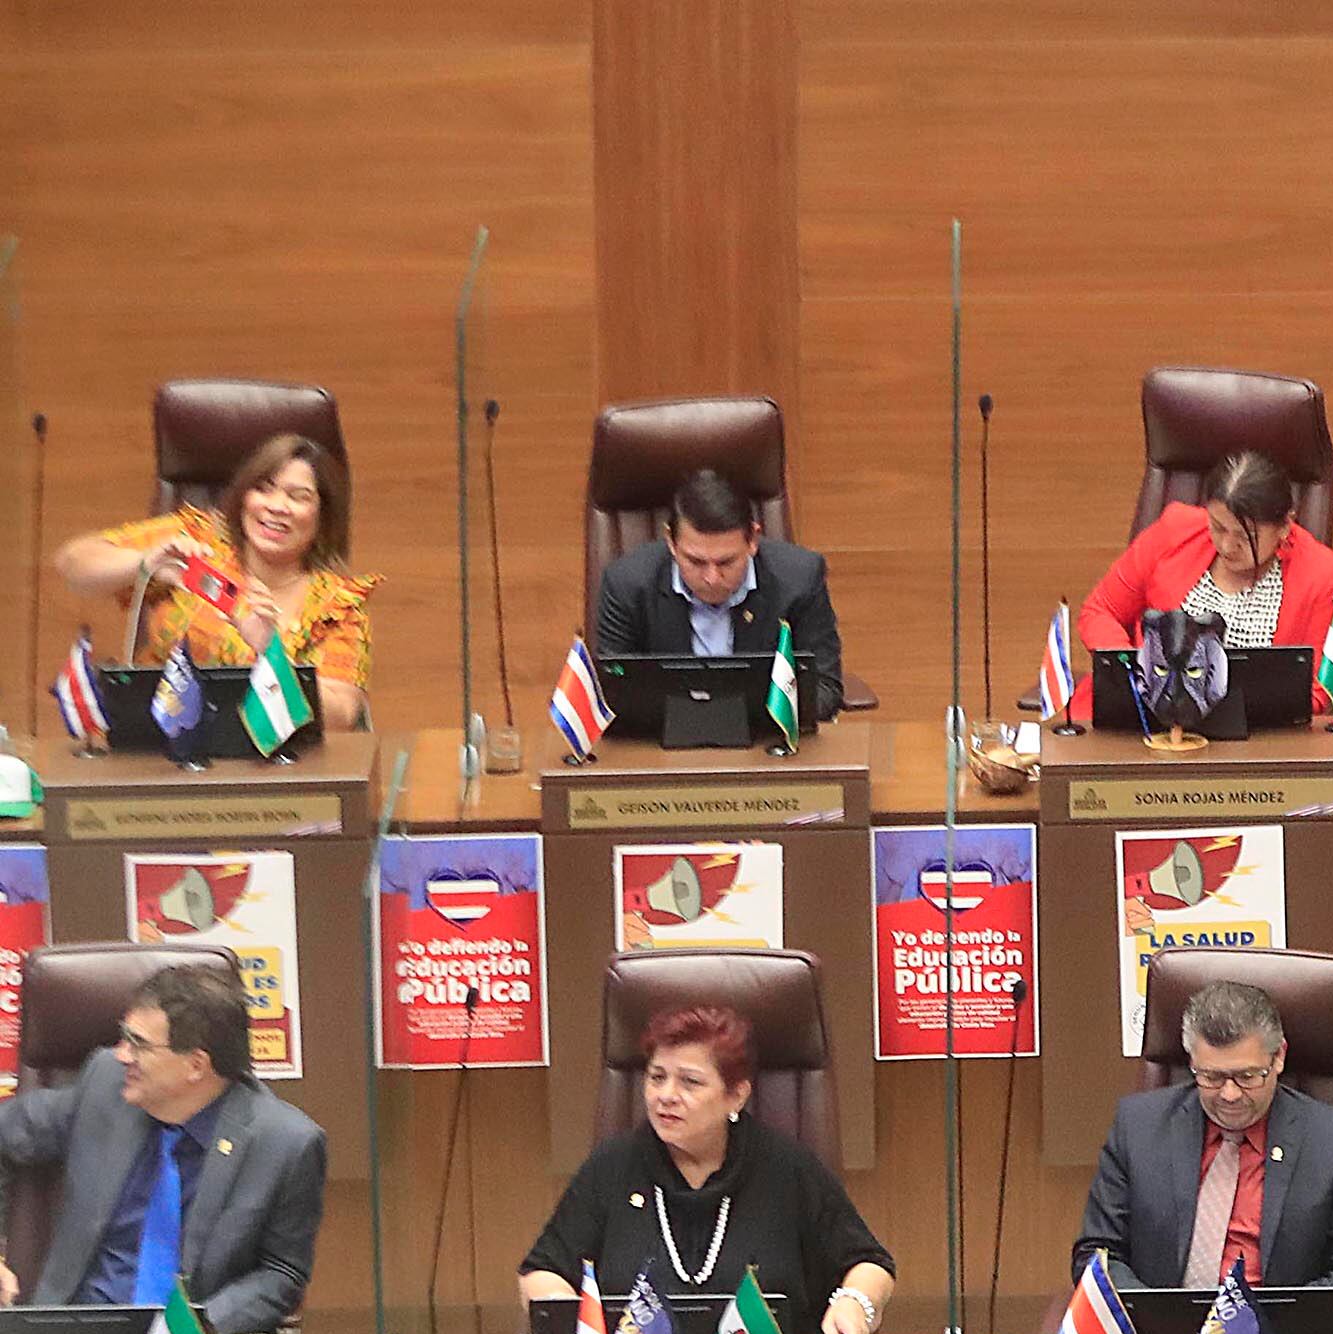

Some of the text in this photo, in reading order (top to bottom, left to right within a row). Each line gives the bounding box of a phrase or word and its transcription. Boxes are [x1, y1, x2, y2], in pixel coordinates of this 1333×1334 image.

[1135, 791, 1178, 804] SONIA
[1183, 791, 1224, 804] ROJAS
[618, 802, 670, 814] GEISON
[674, 800, 739, 813] VALVERDE
[1150, 932, 1254, 947] LA SALUD
